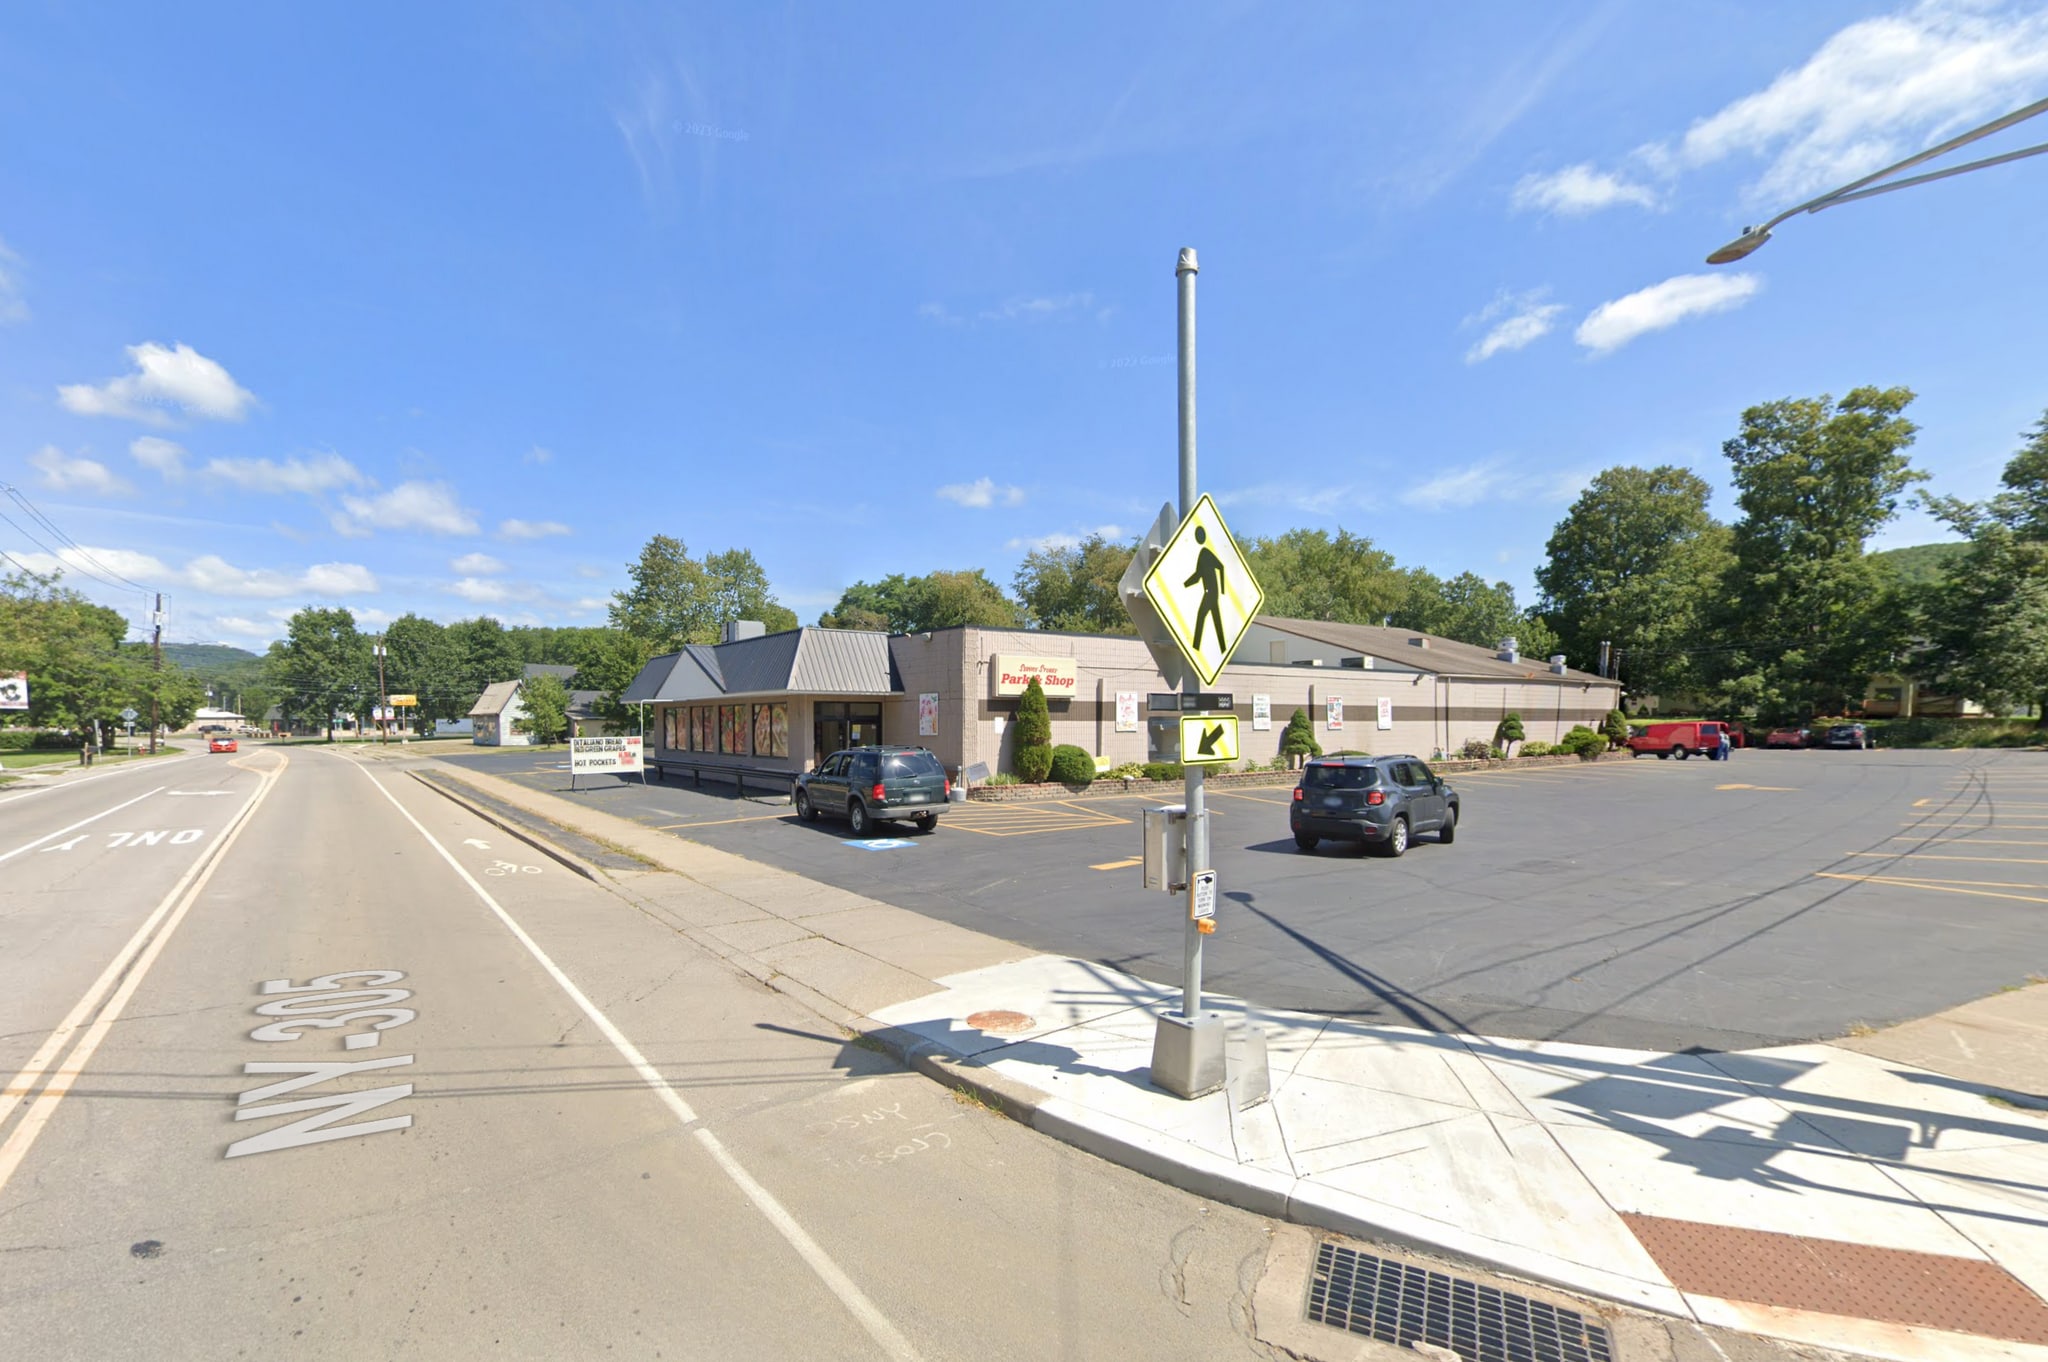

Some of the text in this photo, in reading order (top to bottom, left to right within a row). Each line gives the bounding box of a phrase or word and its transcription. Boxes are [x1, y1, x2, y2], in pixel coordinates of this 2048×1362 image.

[1001, 673, 1030, 684] Park
[1045, 675, 1074, 688] Shop
[40, 829, 204, 852] ONLY
